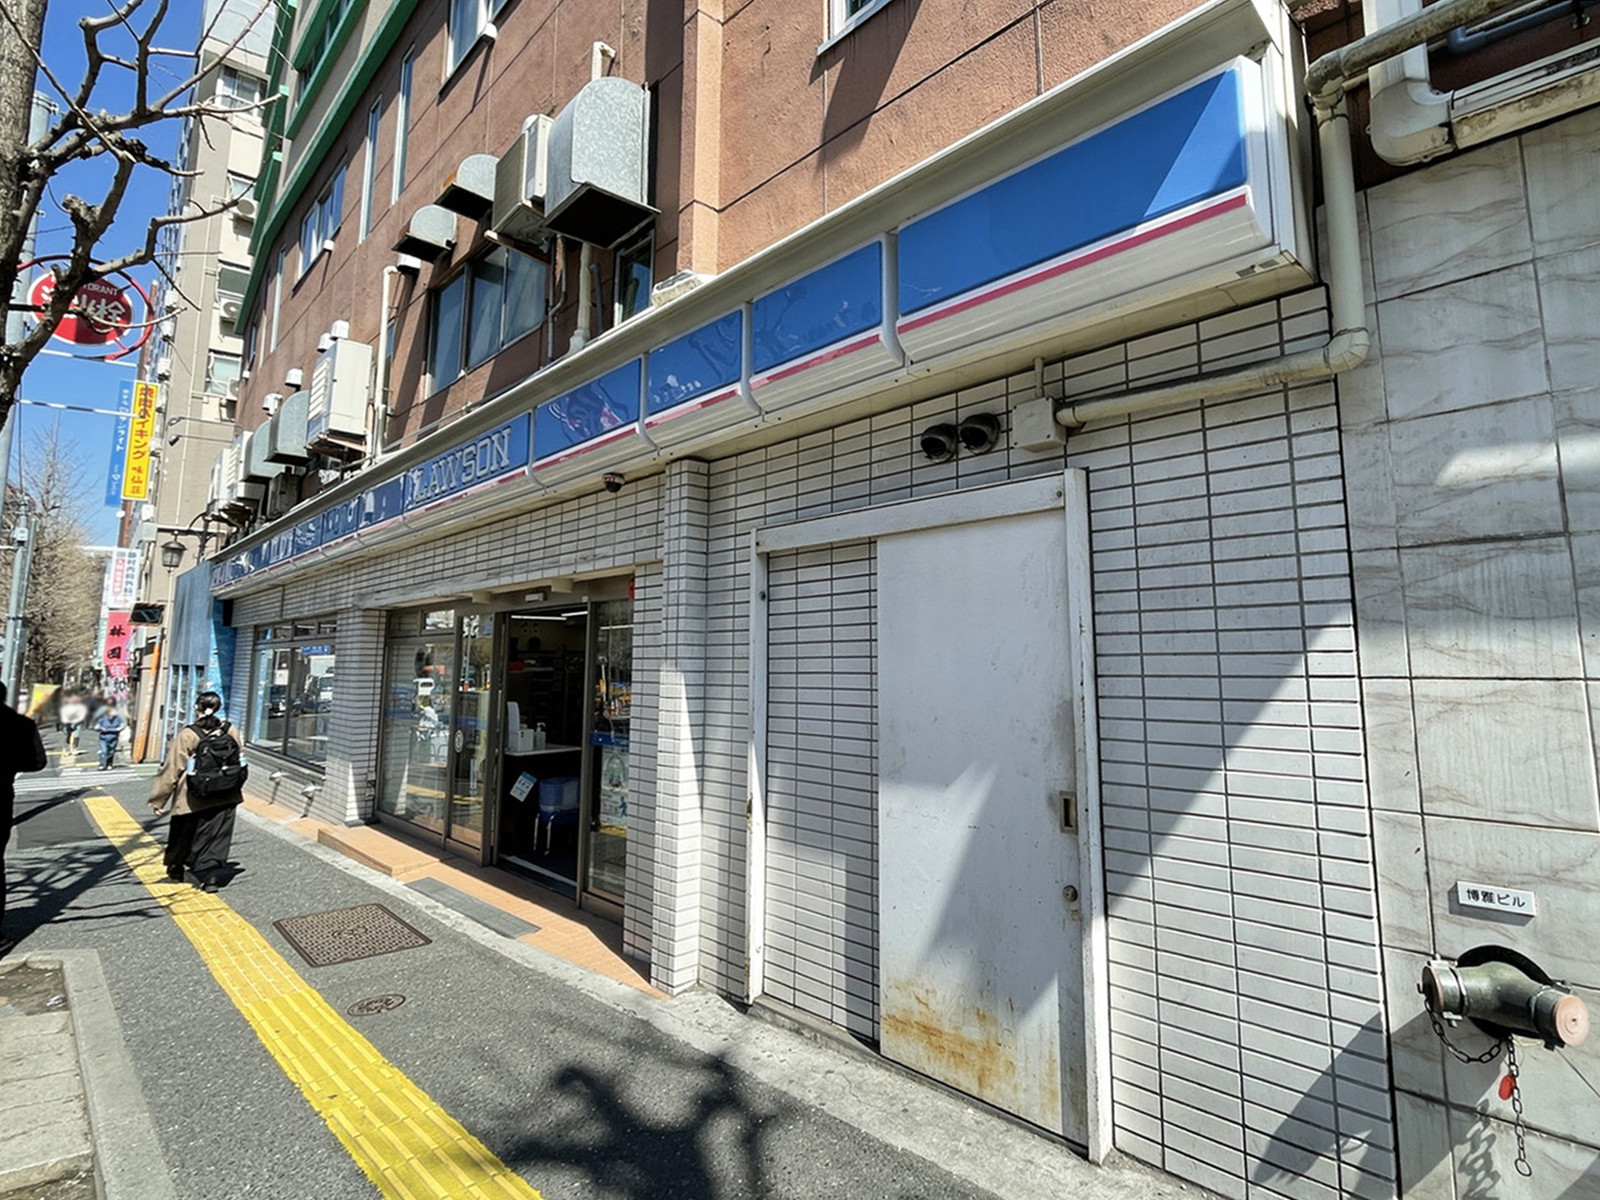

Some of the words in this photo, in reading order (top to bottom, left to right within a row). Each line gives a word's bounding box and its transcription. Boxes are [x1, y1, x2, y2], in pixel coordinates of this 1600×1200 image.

[412, 429, 511, 503] LAWSON
[1466, 888, 1525, 908] 博雅ビル
